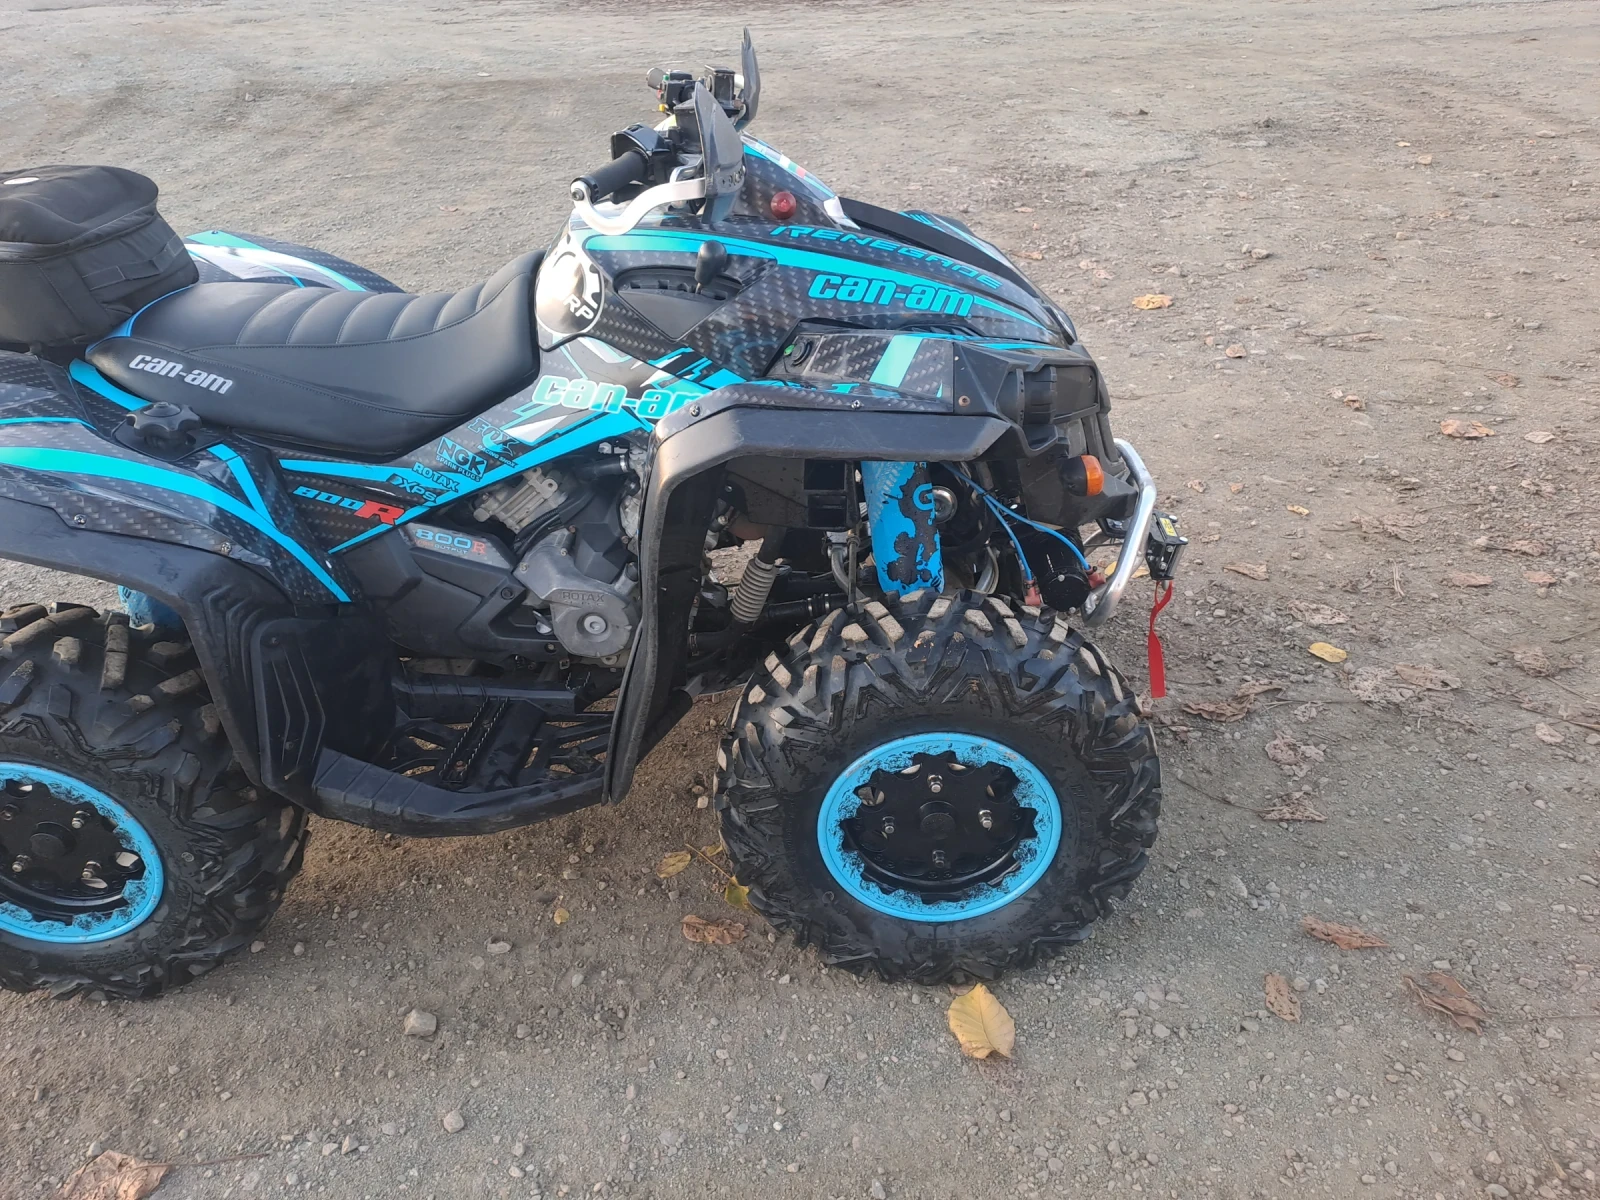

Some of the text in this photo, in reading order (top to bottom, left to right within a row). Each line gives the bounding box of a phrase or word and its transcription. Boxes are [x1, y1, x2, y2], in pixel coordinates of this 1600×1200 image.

[770, 225, 1003, 290] RENEGADE
[808, 274, 975, 317] can-am
[129, 353, 233, 395] can-am
[439, 440, 485, 476] NGK
[477, 444, 500, 459] RACING
[411, 462, 460, 493] ROTAX
[435, 455, 481, 482] SPARK PLUGS
[293, 486, 404, 526] 800R
[415, 528, 486, 555] 800R
[562, 591, 605, 602] ROTAX
